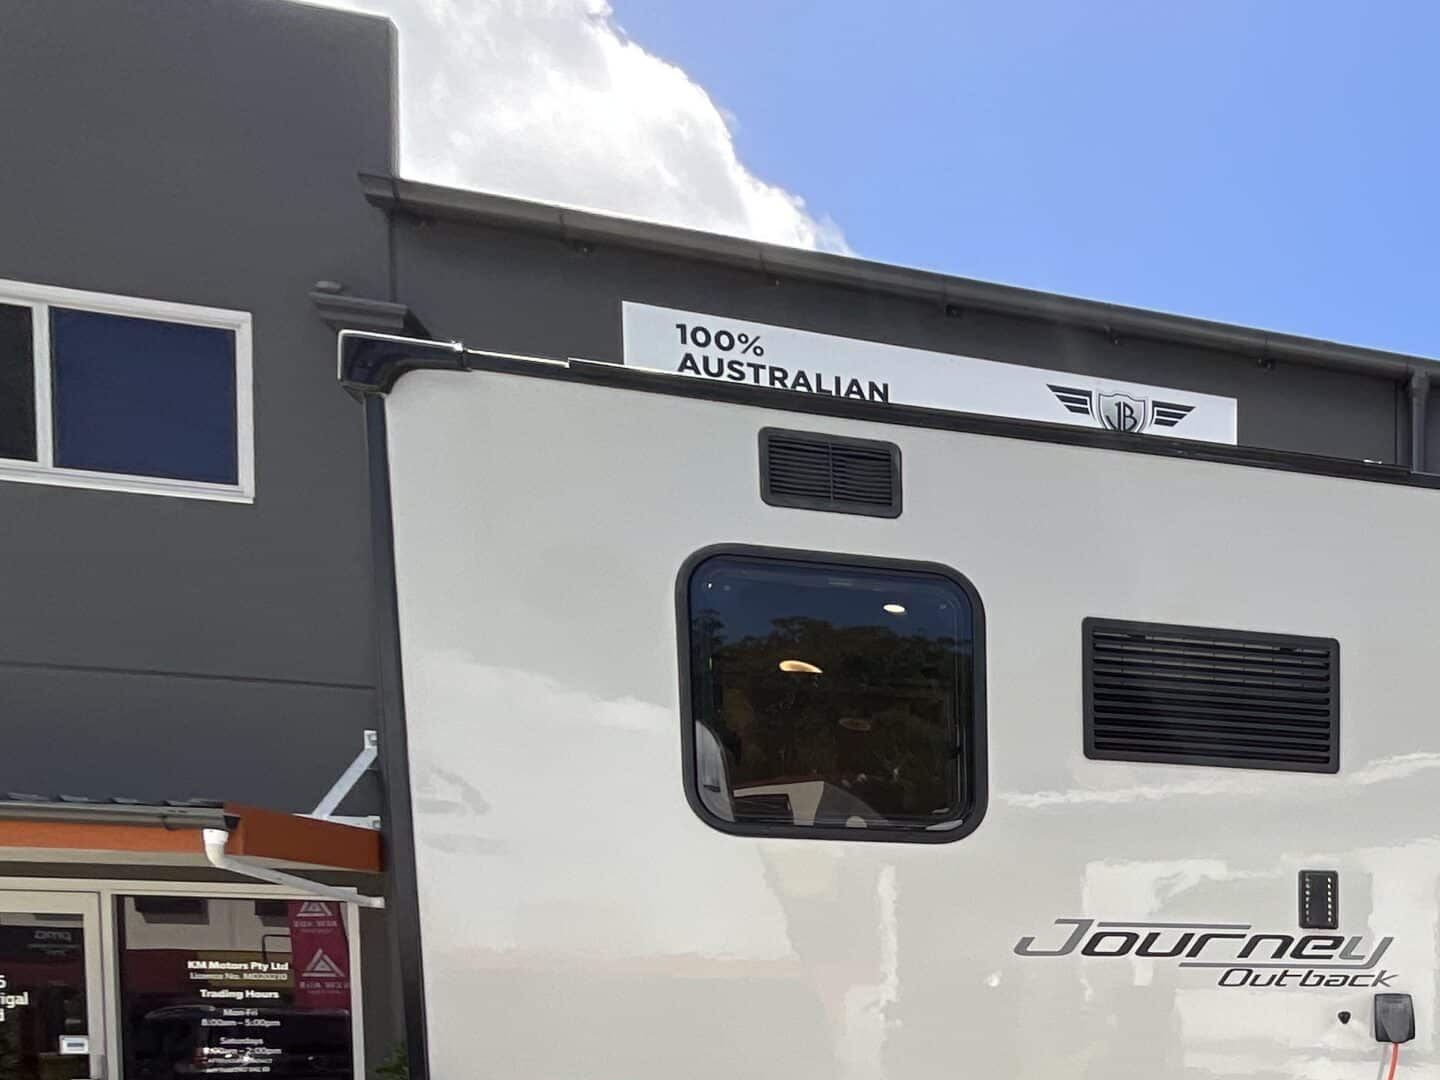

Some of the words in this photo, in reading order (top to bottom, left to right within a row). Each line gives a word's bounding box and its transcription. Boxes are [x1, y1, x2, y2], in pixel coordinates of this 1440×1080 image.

[676, 324, 765, 357] 100%
[677, 352, 890, 403] AUSTRALIAN
[1014, 918, 1396, 970] Journey
[208, 961, 249, 970] Motors
[250, 962, 269, 972] Pty
[271, 962, 289, 971] Ltd
[1217, 968, 1399, 988] Outback
[200, 989, 244, 1000] Trading
[245, 990, 280, 999] Hours
